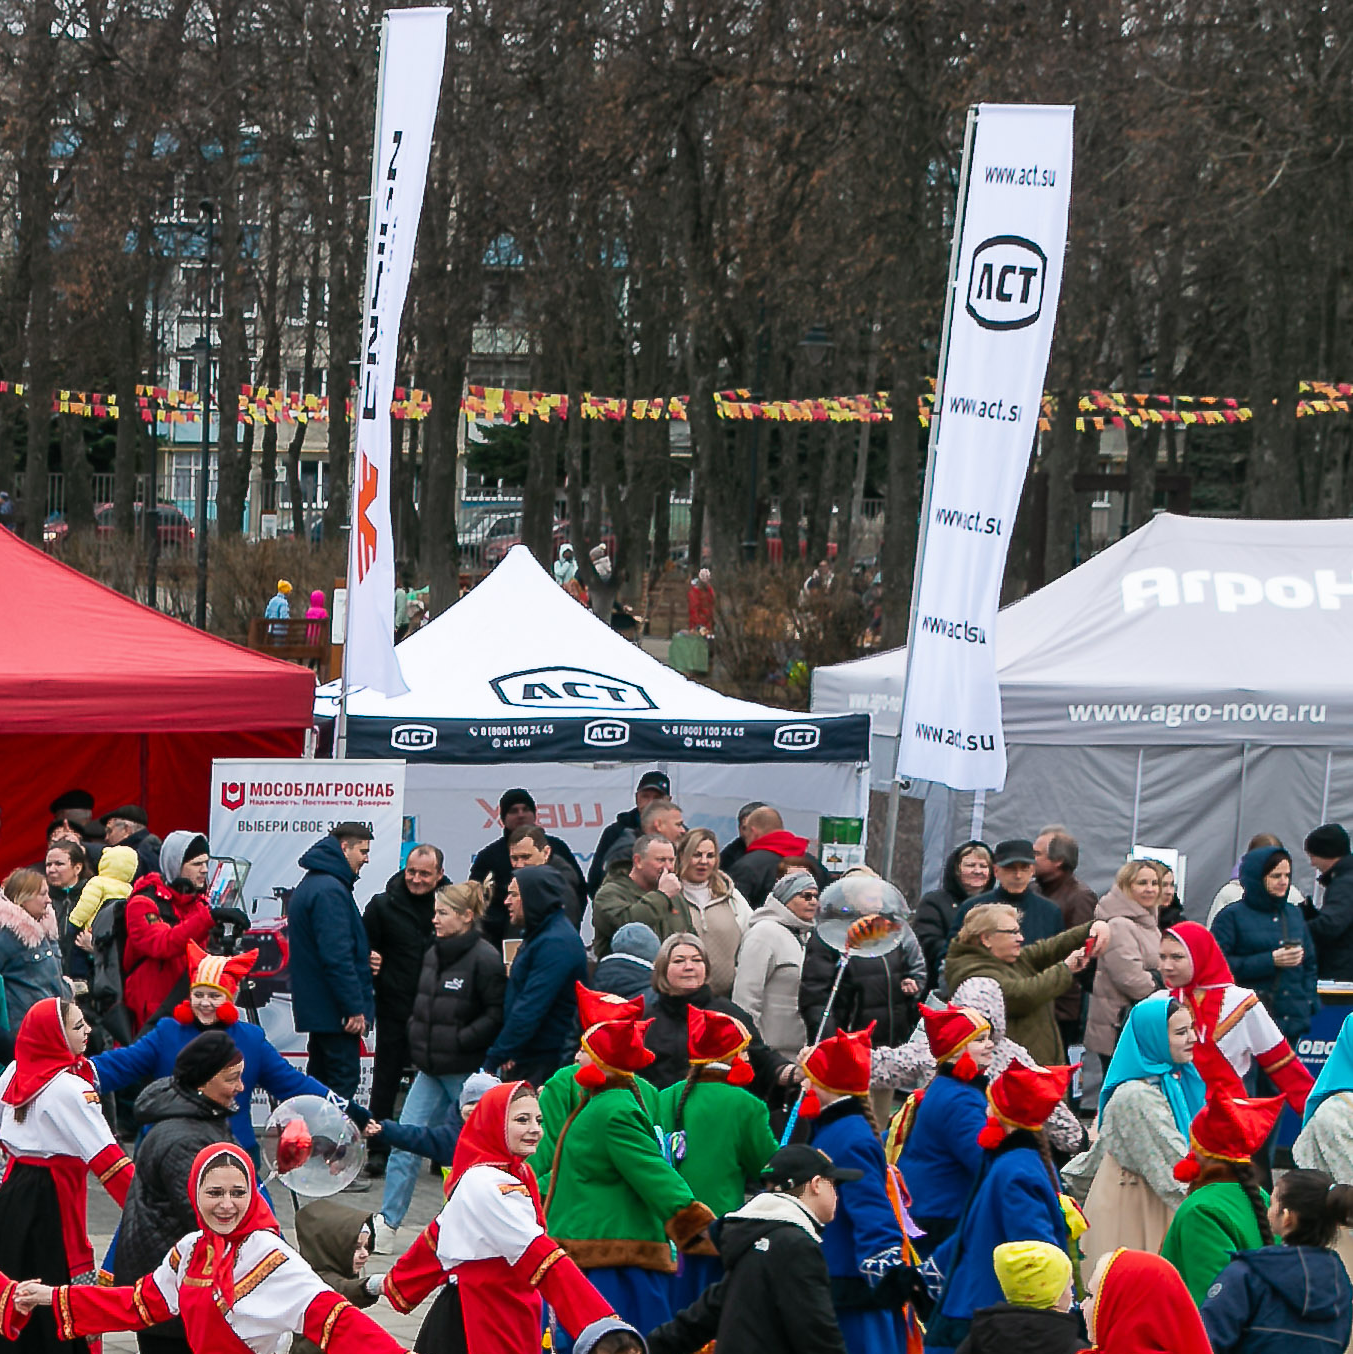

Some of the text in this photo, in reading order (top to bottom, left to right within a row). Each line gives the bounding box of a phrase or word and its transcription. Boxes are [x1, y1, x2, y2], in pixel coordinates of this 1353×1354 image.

[985, 163, 1057, 188] www.act.su
[1067, 702, 1327, 728] www.agro-nova.ru
[480, 724, 554, 736] 8 (800) 100 24 45
[671, 725, 744, 737] 8 (800) 100 24 45
[503, 738, 531, 748] act.su
[695, 738, 722, 748] act.su
[249, 782, 394, 797] МОСОБЛАГРОСНАБ
[249, 799, 301, 807] Надежность.
[356, 799, 394, 808] Доверие.
[238, 821, 289, 833] ВЫБЕРИ
[292, 820, 323, 833] СВОЕ
